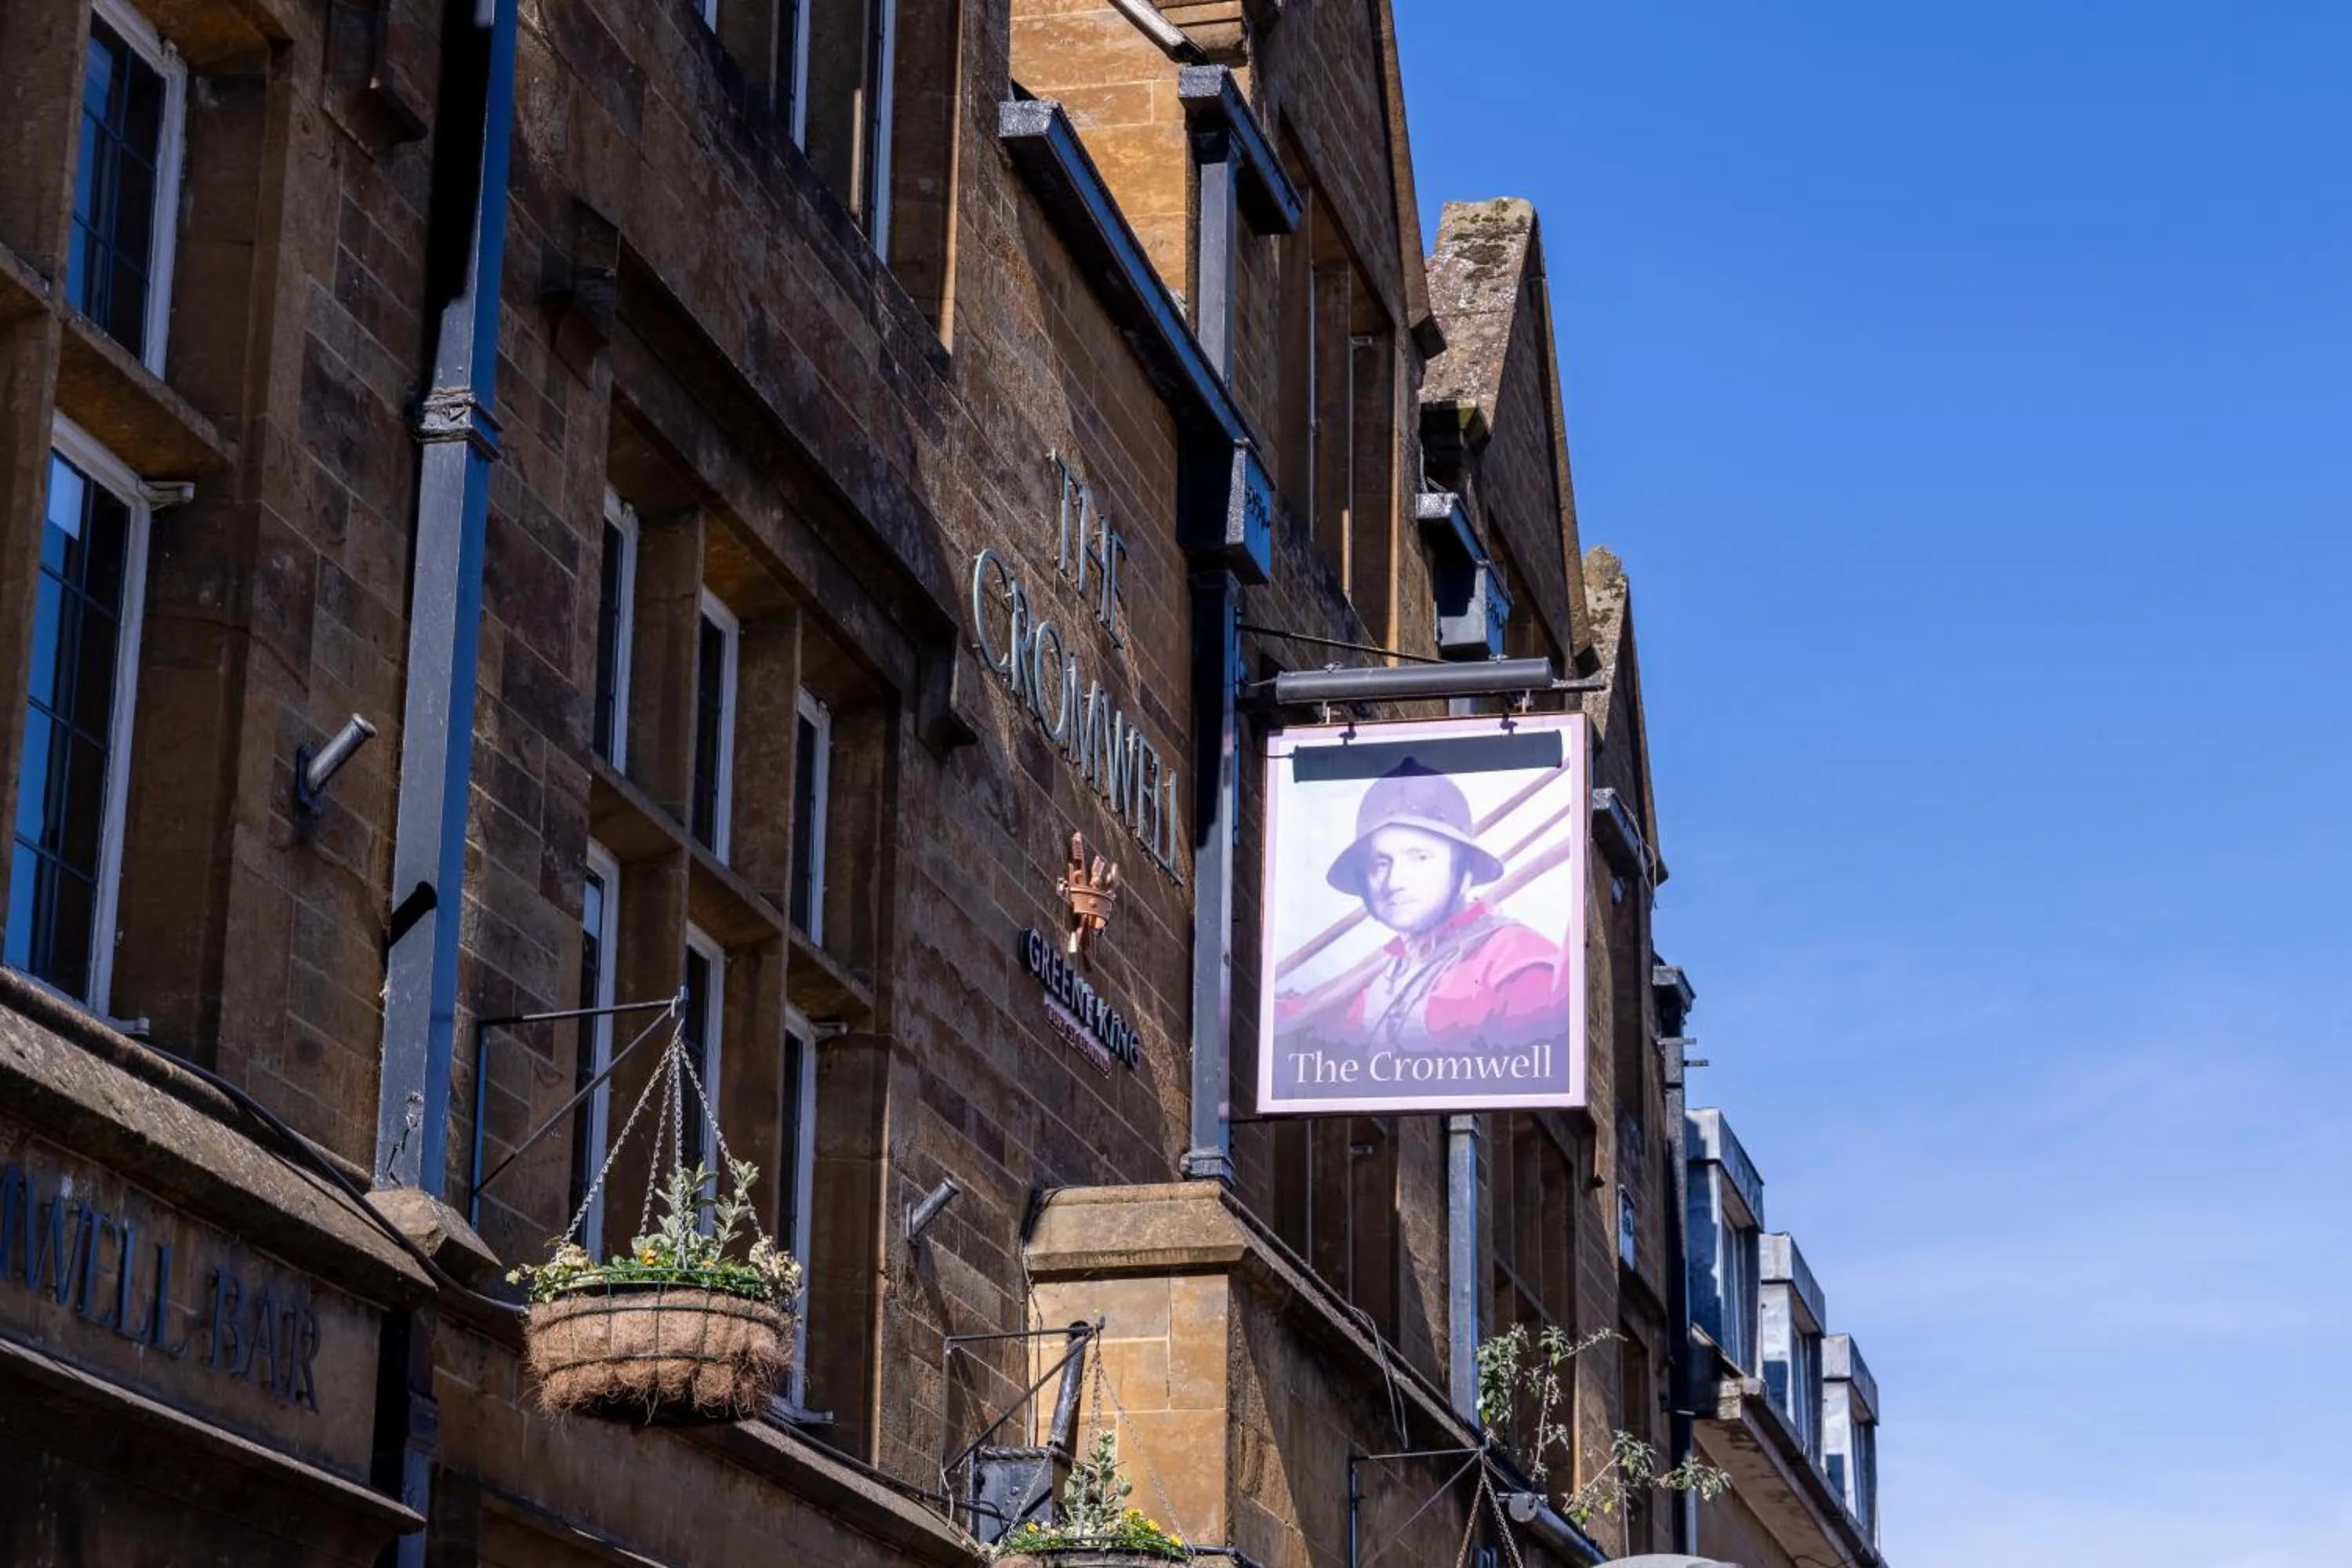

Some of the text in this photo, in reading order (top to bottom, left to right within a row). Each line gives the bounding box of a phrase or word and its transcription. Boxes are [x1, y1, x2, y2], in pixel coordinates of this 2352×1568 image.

[1049, 448, 1126, 648] THE
[973, 549, 1184, 887] CROMWELL
[1025, 929, 1094, 1029] GREENE
[1096, 997, 1141, 1071] KING
[1289, 1045, 1553, 1083] The Cromwell
[202, 1268, 320, 1414] BAR
